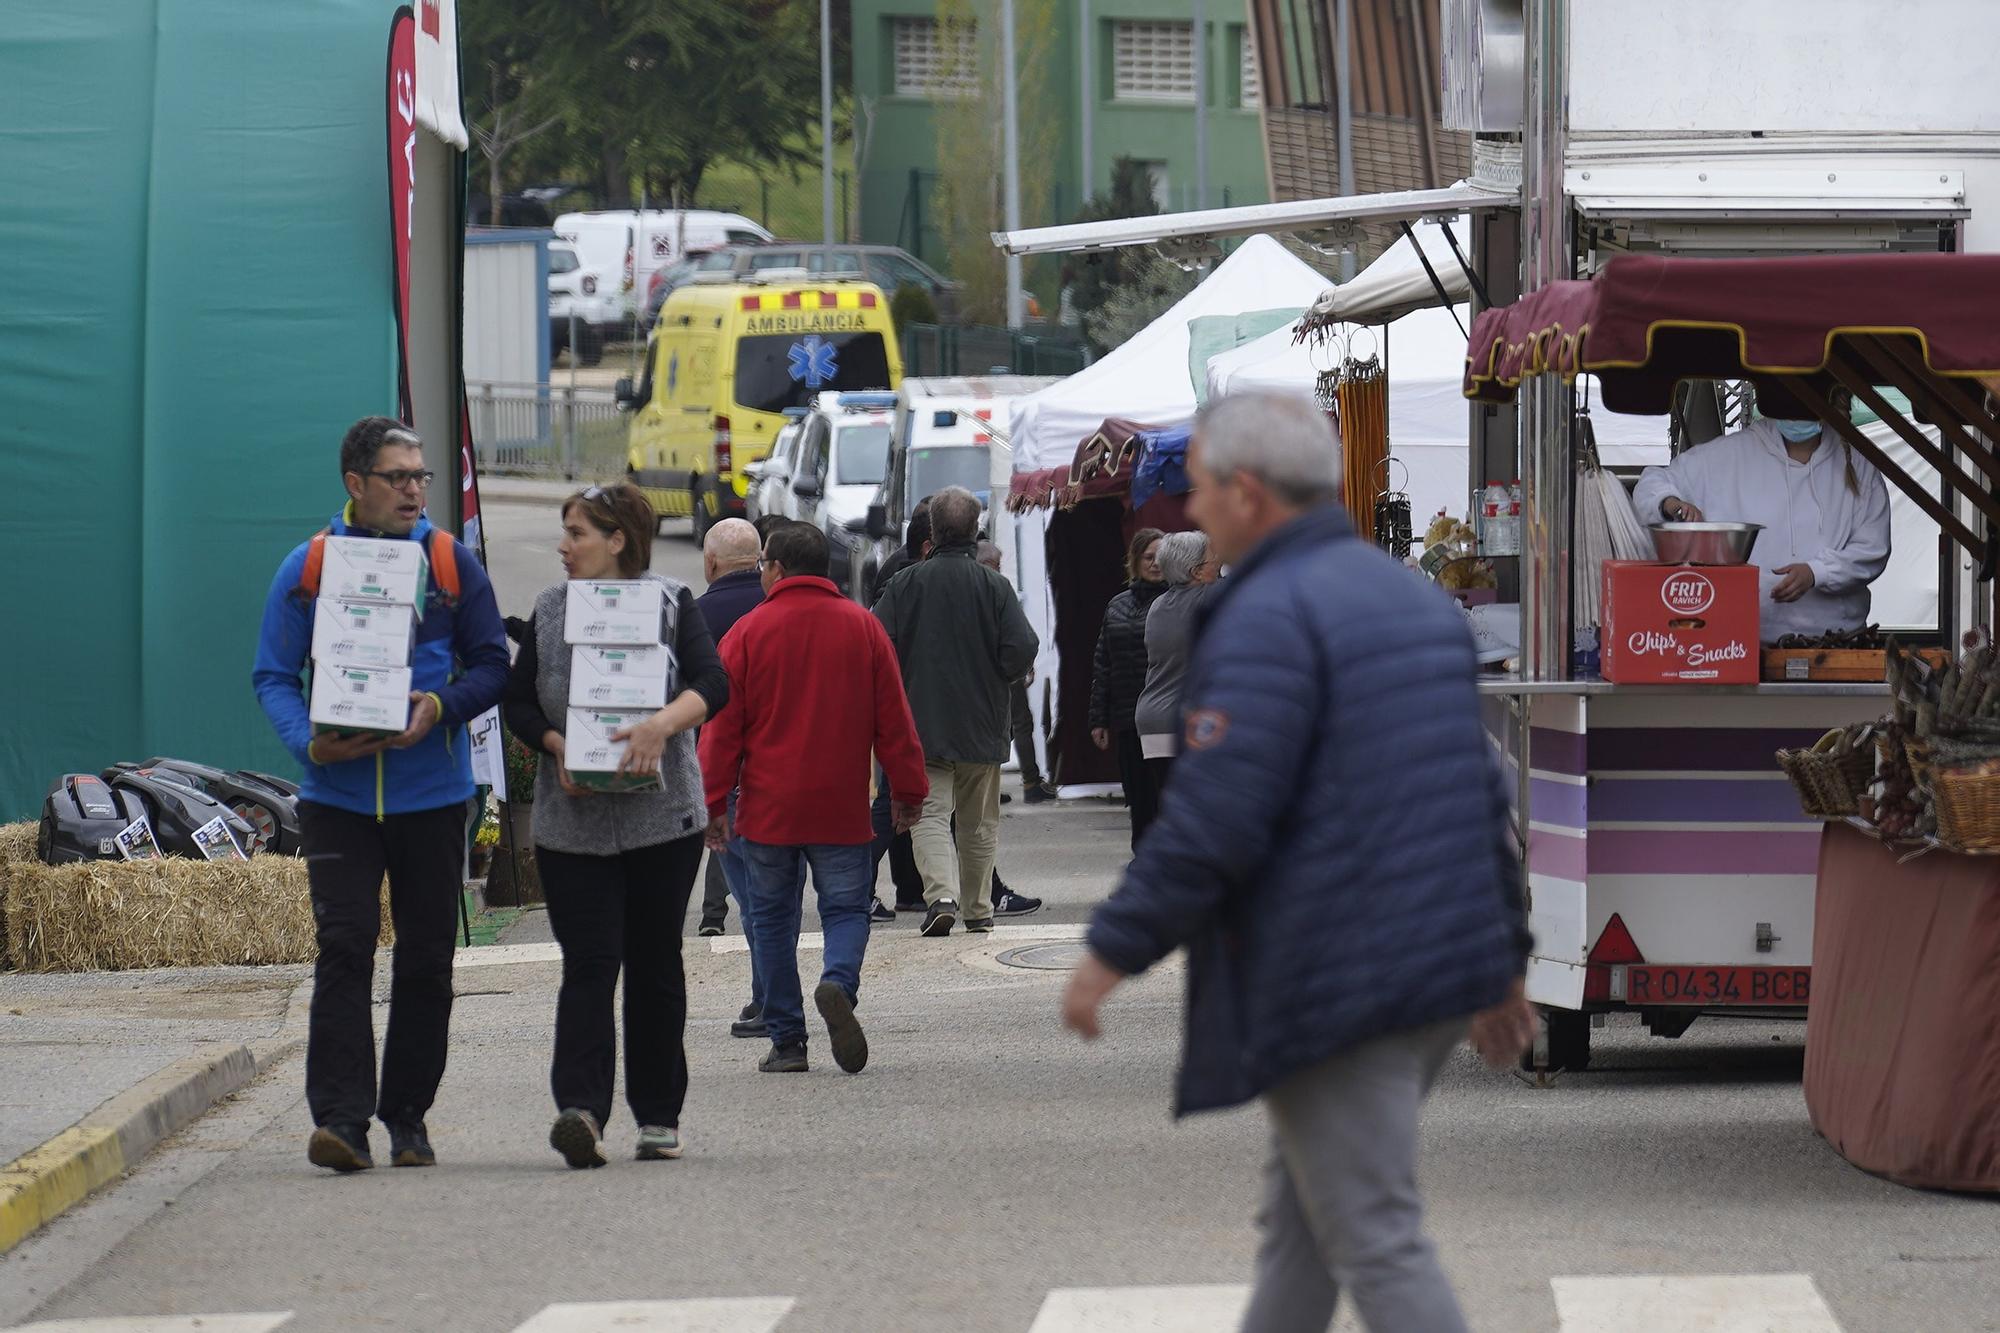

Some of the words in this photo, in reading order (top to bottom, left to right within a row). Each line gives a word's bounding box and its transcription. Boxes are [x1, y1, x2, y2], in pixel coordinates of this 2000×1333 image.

[1669, 582, 1707, 597] FRIT
[1628, 631, 1677, 655] Chips
[1677, 644, 1685, 655] &
[1687, 639, 1748, 666] Snacks
[1632, 969, 1650, 998] R
[1662, 970, 1740, 999] 0434
[1752, 970, 1810, 1000] BCB
